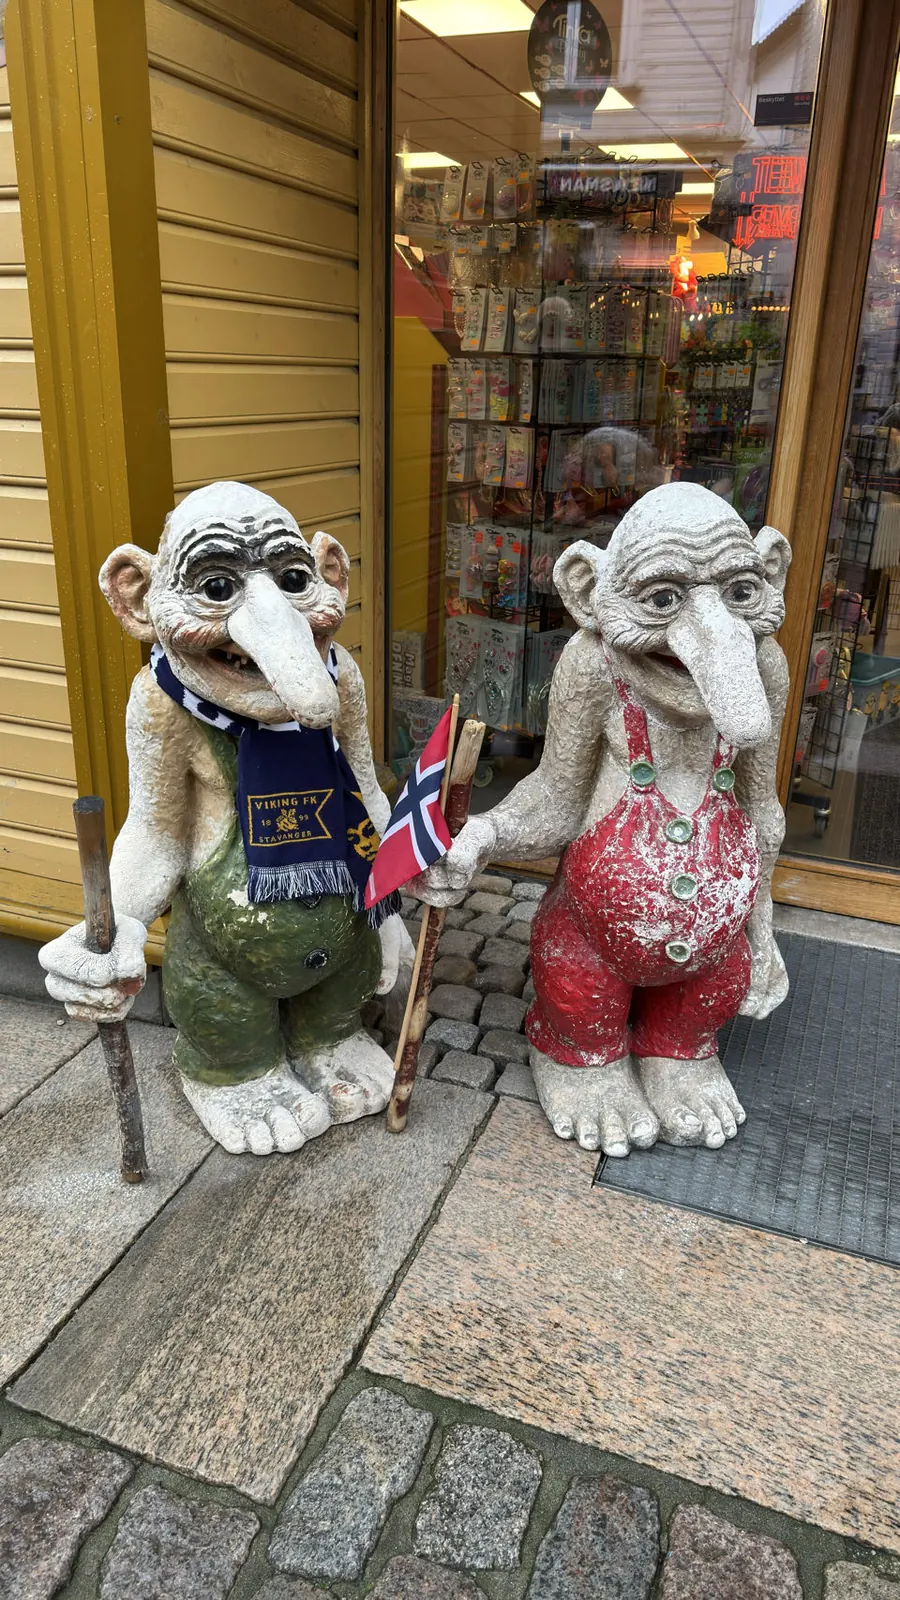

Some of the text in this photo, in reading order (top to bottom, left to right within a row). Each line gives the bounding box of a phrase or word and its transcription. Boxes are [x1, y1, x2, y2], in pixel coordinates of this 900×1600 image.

[255, 795, 317, 810] VIKING FK
[261, 819, 272, 827] 18
[258, 830, 312, 843] STAVANGER
